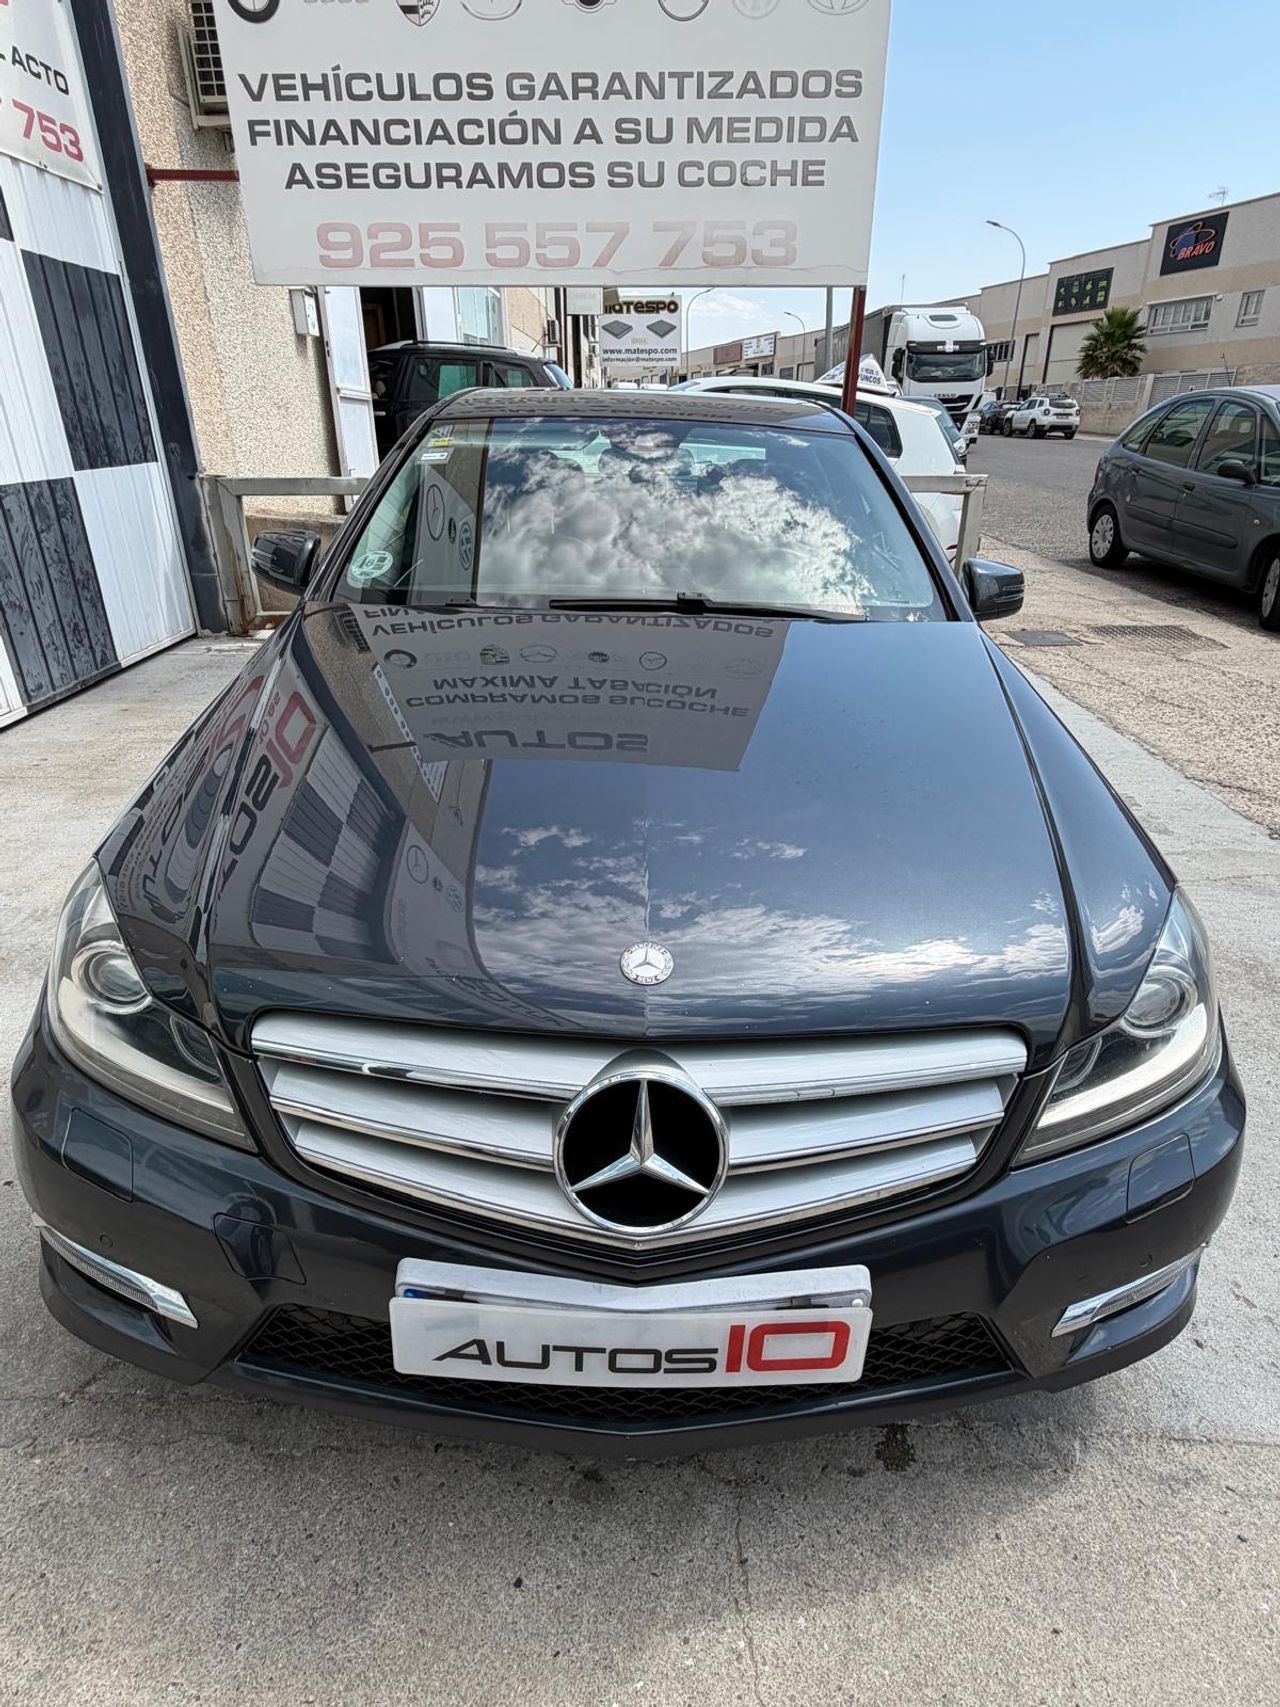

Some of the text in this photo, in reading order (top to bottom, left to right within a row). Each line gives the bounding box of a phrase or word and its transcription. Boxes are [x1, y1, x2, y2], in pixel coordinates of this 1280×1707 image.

[12, 45, 70, 96] ACTO
[238, 64, 864, 102] VEHÍCULOS GARANTIZADOS
[12, 98, 84, 163] 753
[247, 109, 860, 147] FINANCIACIÓN A SU MEDIDA
[285, 159, 826, 190] ASEGURAMOS SU COCHE
[316, 219, 798, 269] 925 557 753
[1178, 242, 1215, 260] BRAVO
[602, 347, 678, 356] www.matespo.com
[432, 1320, 851, 1375] AUTOS10
